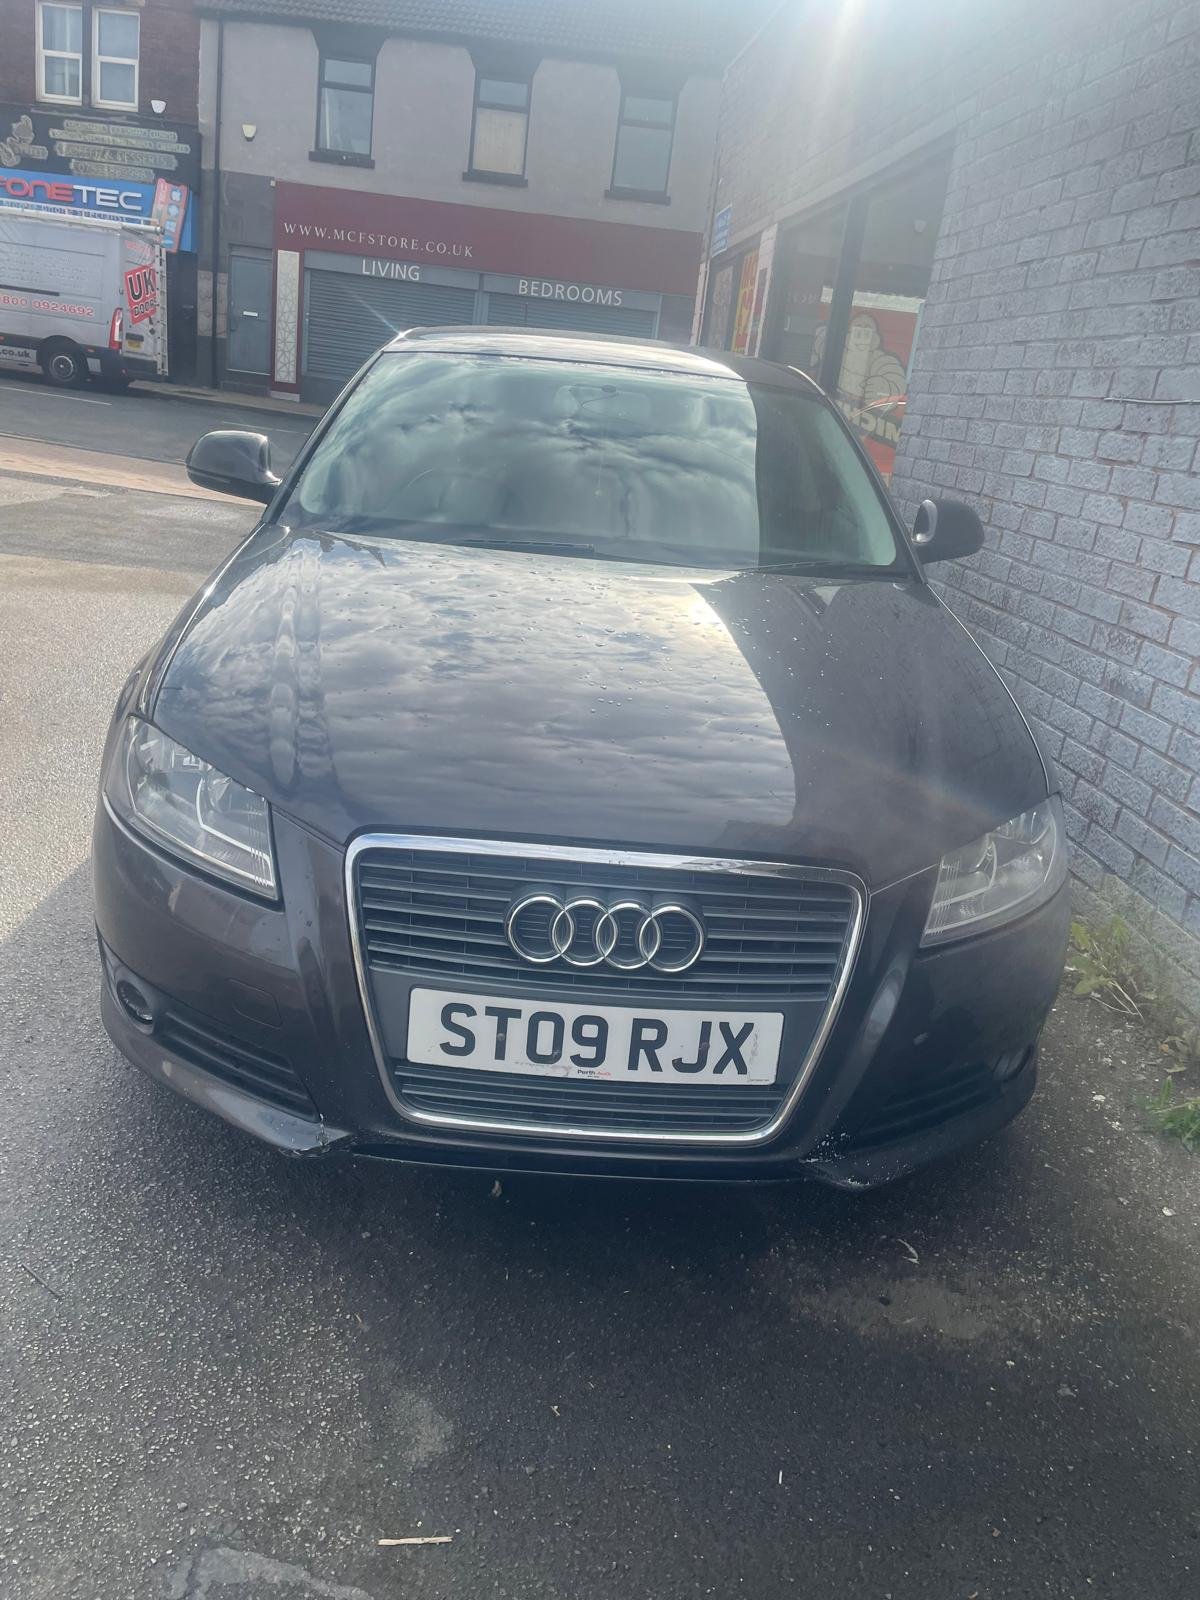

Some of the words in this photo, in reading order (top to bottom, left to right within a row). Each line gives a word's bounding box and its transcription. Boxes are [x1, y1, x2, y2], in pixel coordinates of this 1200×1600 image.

[284, 222, 474, 258] WWW.MCFSTORE.CO.UK
[127, 268, 156, 302] UK
[362, 259, 421, 281] LIVING
[0, 295, 28, 307] 800
[519, 279, 623, 306] BEDROOMS
[440, 1003, 609, 1069] ST09
[628, 1017, 755, 1076] RJX
